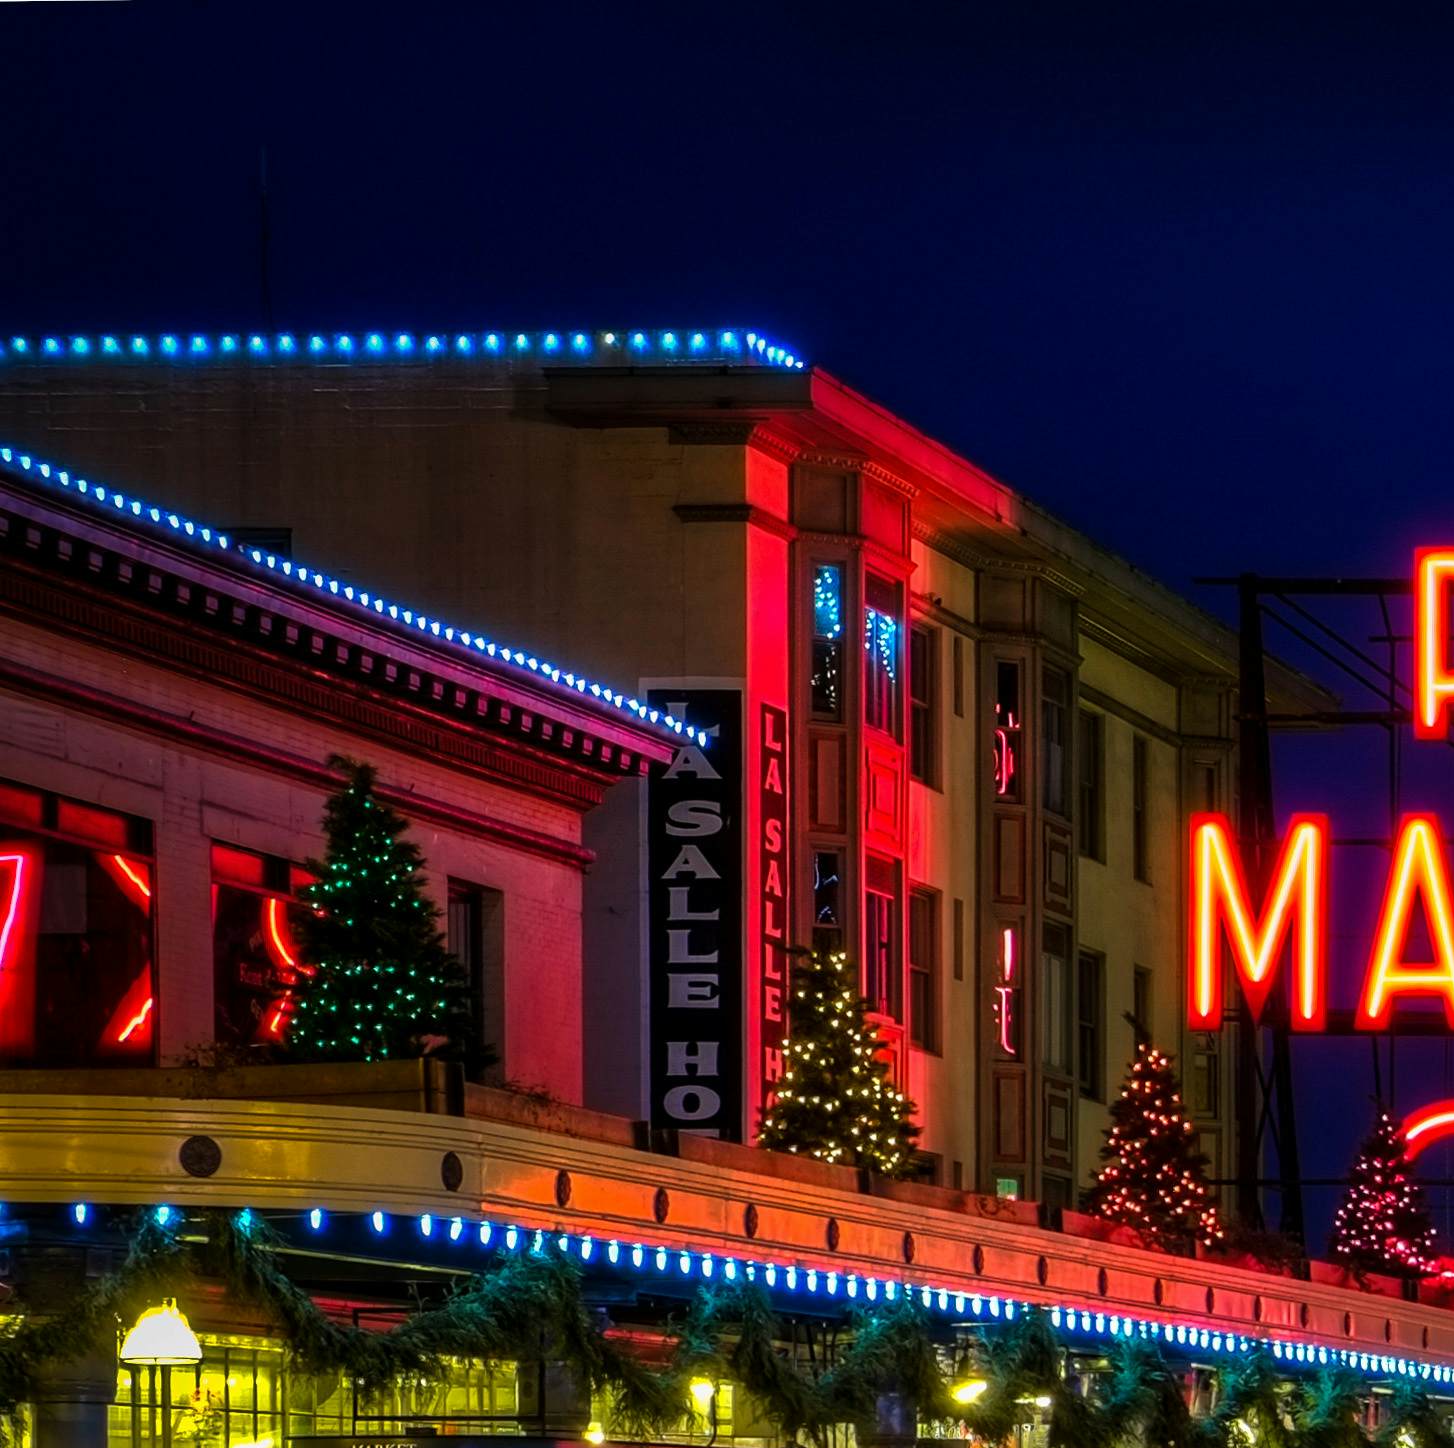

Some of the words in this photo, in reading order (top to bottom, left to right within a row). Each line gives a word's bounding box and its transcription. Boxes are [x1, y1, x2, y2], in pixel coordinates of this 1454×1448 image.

[764, 712, 783, 795] LA
[661, 800, 723, 1009] SALLE
[764, 818, 783, 1022] SALLE
[663, 1041, 722, 1138] HO
